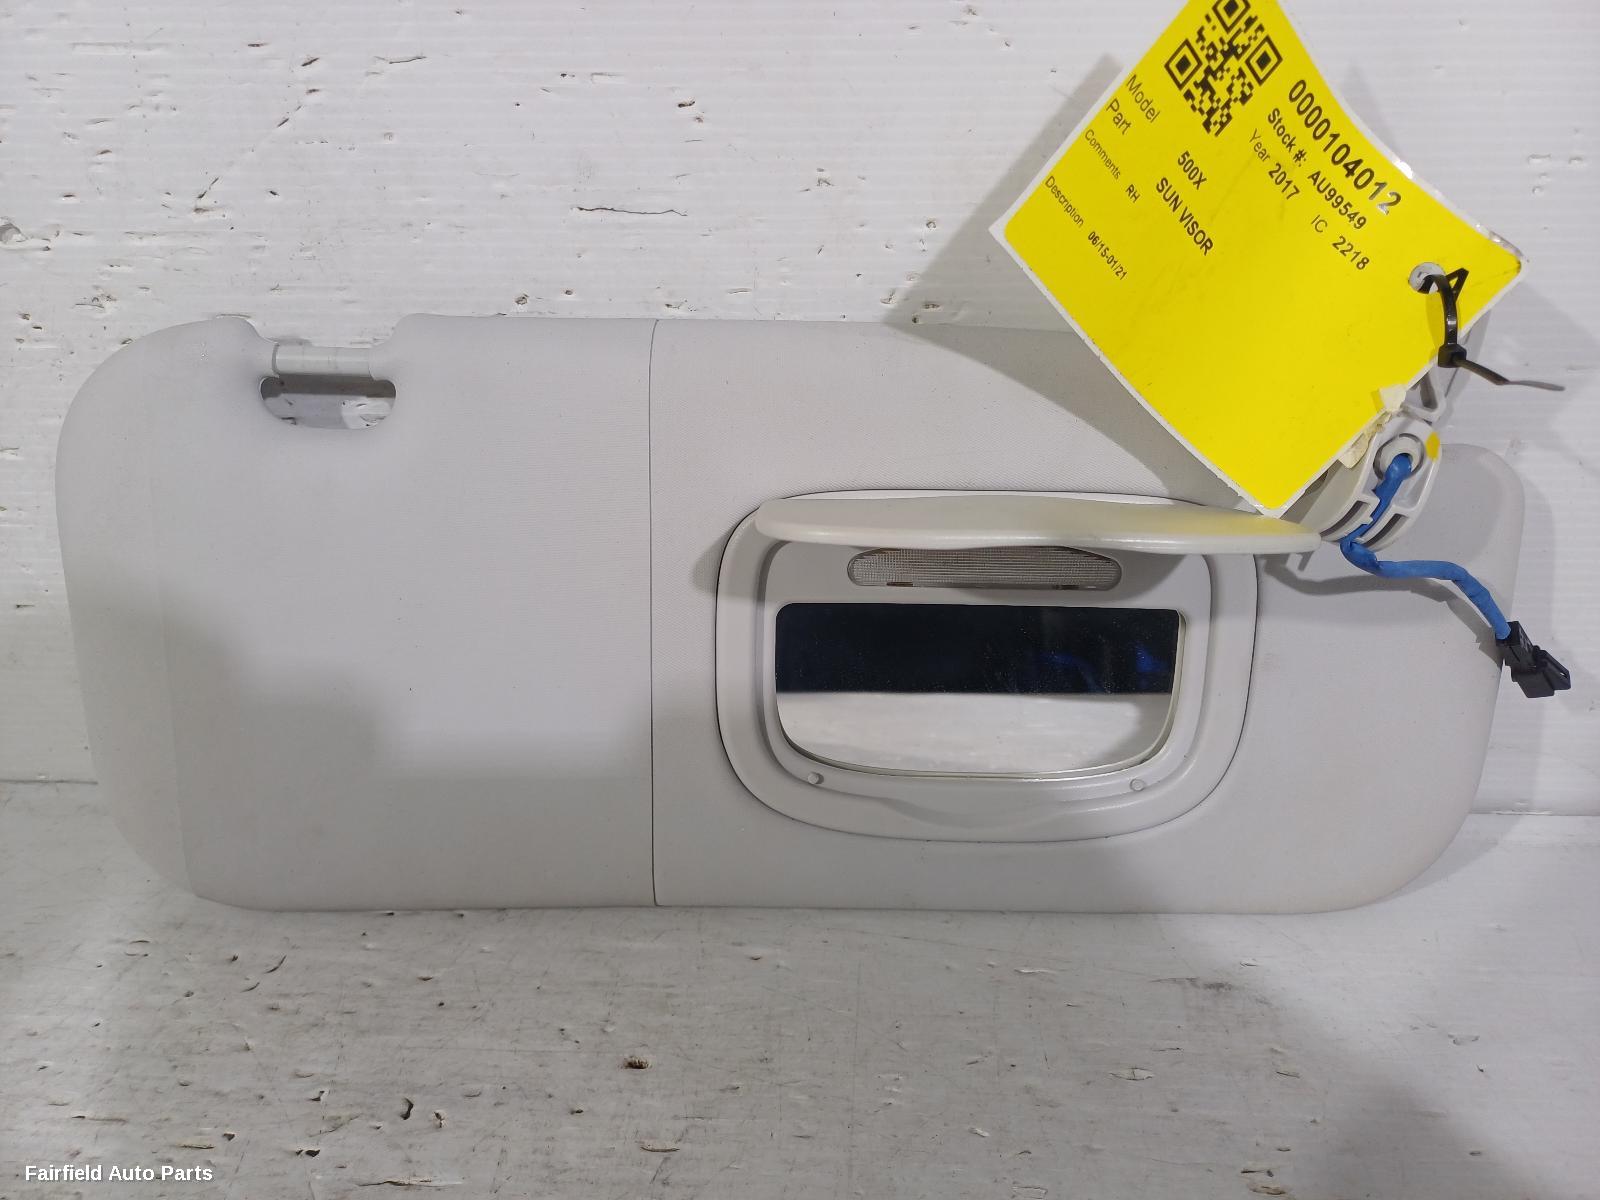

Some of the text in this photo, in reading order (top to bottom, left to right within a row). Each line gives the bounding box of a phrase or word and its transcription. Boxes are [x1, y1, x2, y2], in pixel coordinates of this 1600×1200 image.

[1084, 129, 1141, 203] Comments RH
[1105, 98, 1214, 257] Part SUN VISOR
[1126, 74, 1208, 191] Model 500X
[1267, 107, 1297, 153] Stock
[1307, 170, 1367, 230] AU99549
[1288, 79, 1402, 215] 0000104012
[1045, 175, 1128, 281] Description 06/15-01/21
[1249, 128, 1370, 271] Year 2017 IC 2218
